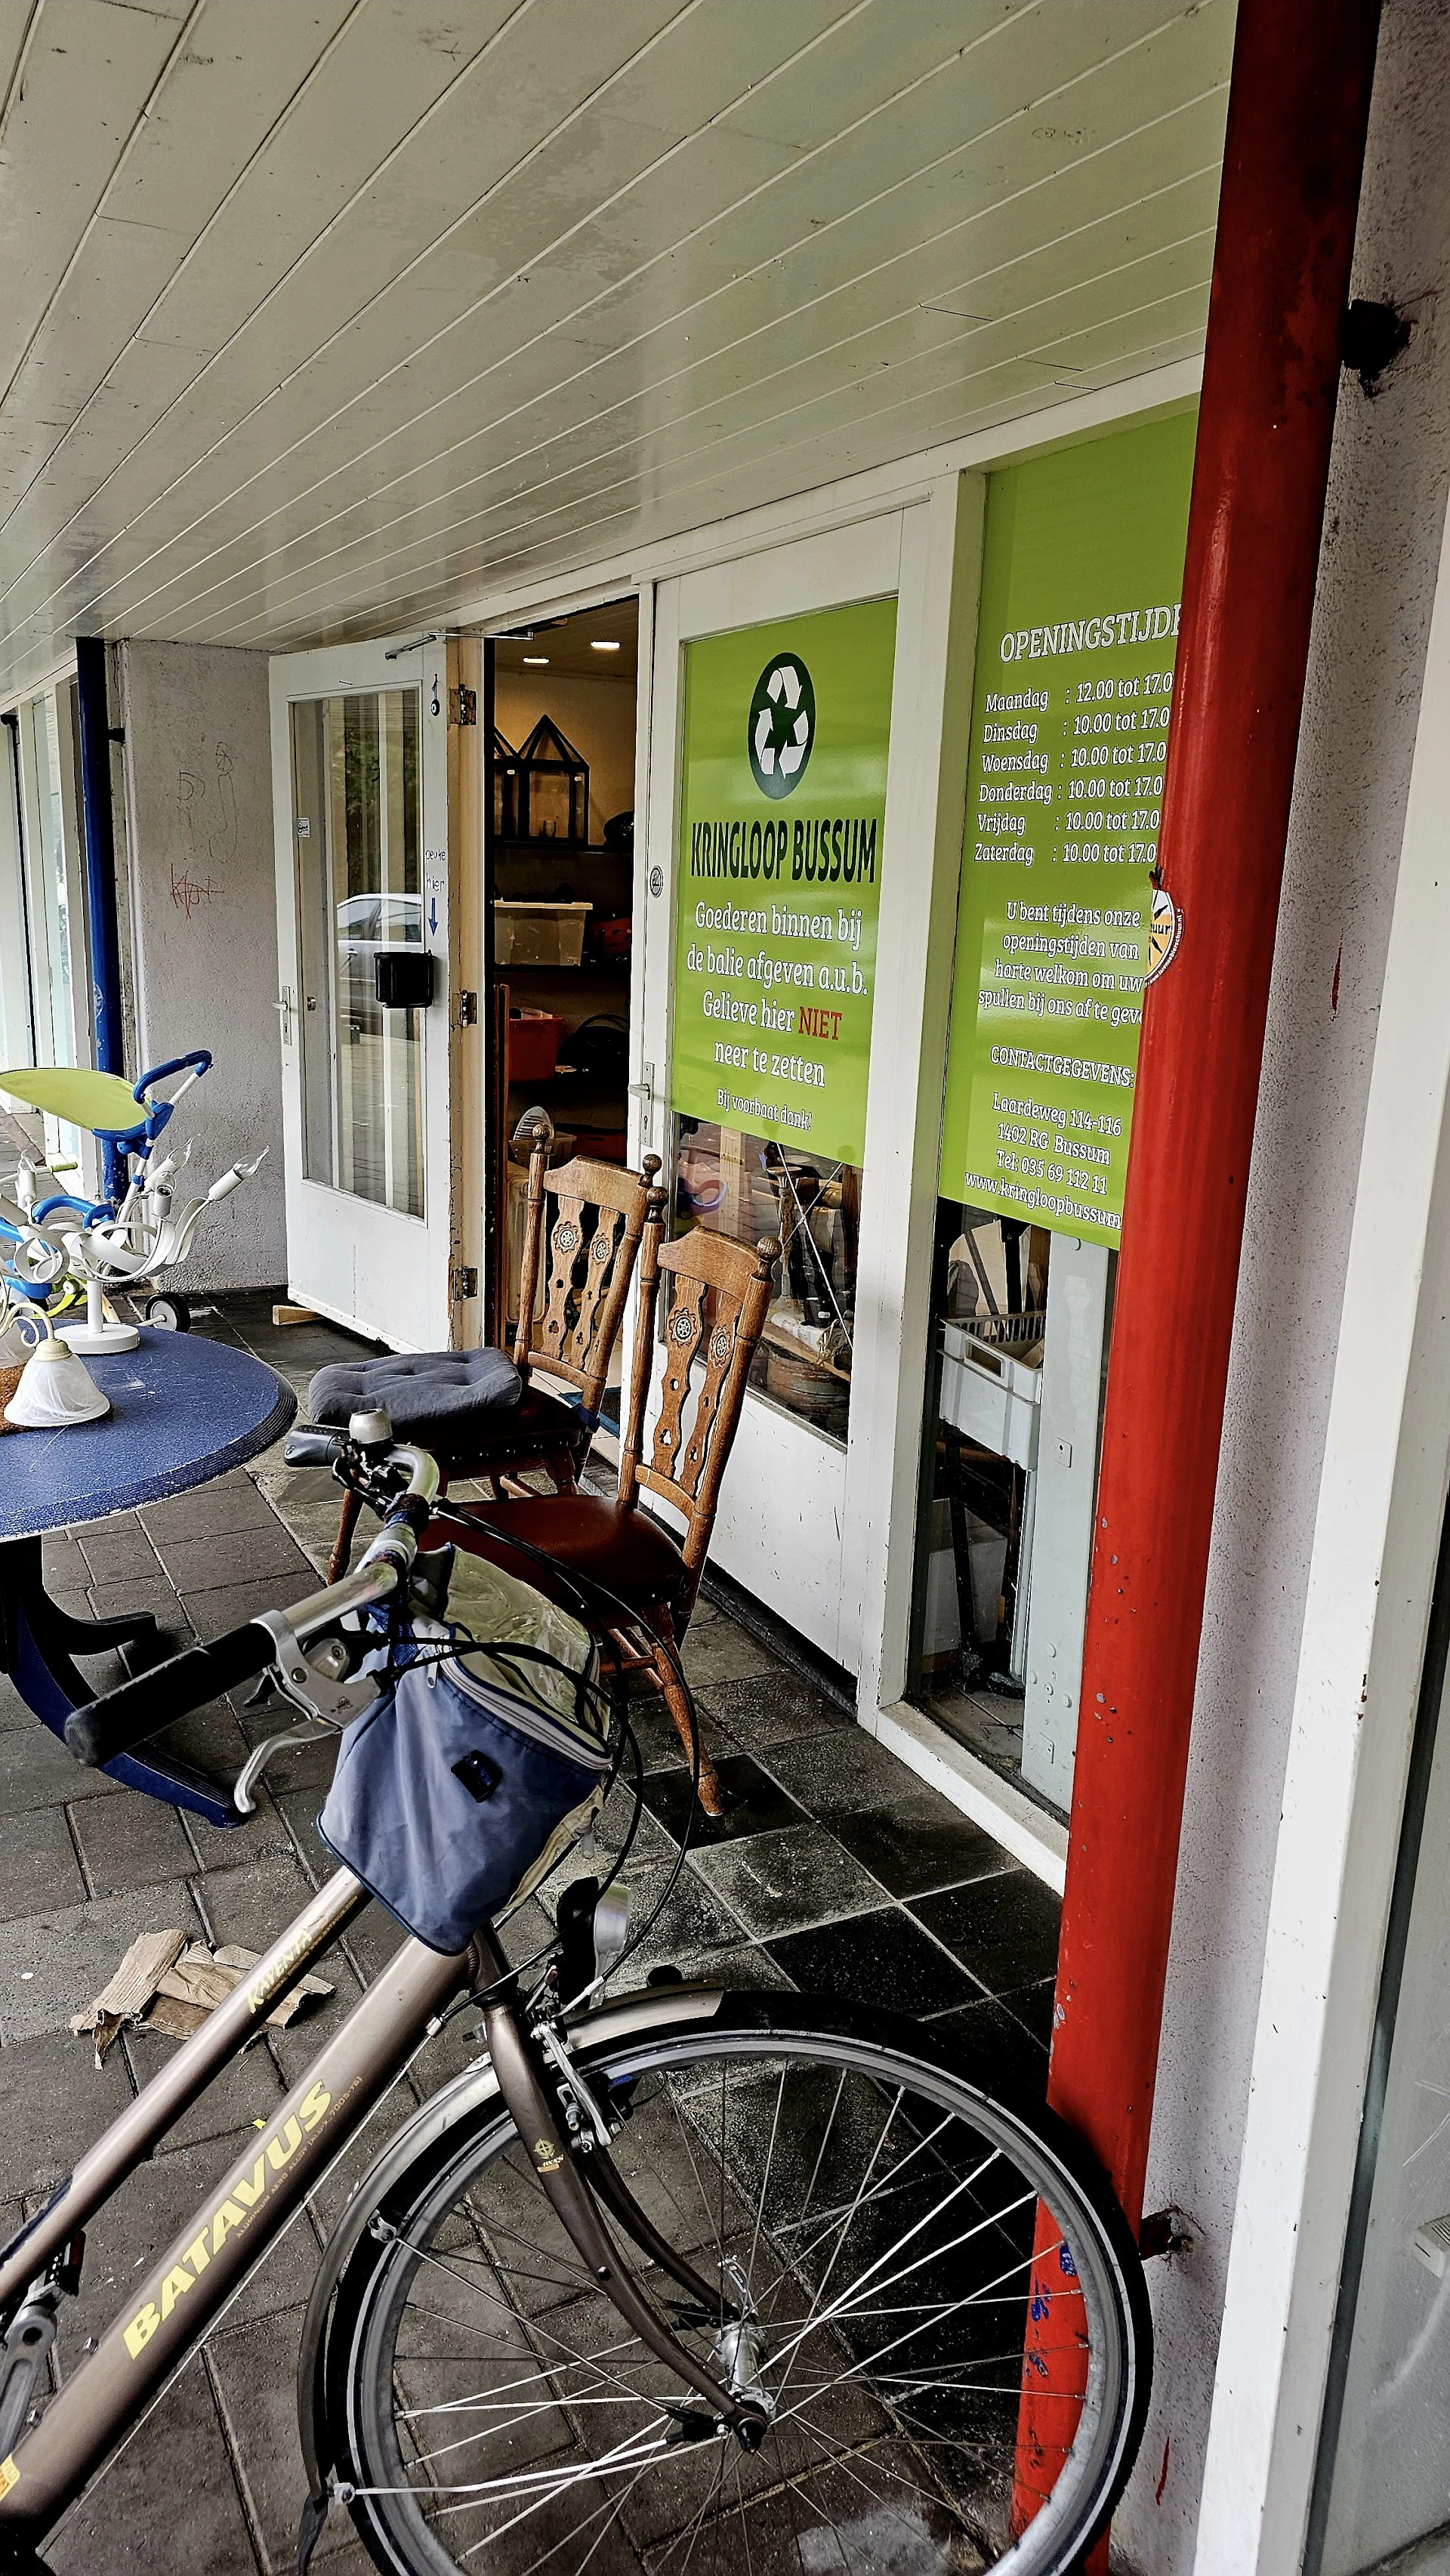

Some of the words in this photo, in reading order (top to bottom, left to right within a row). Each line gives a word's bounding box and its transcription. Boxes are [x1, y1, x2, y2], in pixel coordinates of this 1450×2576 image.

[999, 603, 1181, 663] OPENINGSTIJD
[985, 688, 1049, 712] Maandag
[1076, 679, 1115, 703] 12.00
[1118, 677, 1140, 697] tot
[1143, 671, 1173, 695] 17.0
[983, 720, 1038, 744] Dinsdag
[1073, 712, 1112, 735] 10.00
[1115, 711, 1137, 733] tot
[1140, 706, 1171, 730] 17.0
[981, 750, 1050, 774] Woensdag
[1070, 746, 1109, 768] 10.00
[1112, 744, 1134, 765] tot
[1137, 741, 1167, 764] 17.0
[979, 781, 1053, 806] Donderdag
[1067, 779, 1106, 801] 10.00
[1109, 777, 1131, 798] tot
[1134, 775, 1164, 797] 17.0
[977, 812, 1026, 837] Vrijdag
[1065, 811, 1103, 831] 10.00
[1106, 810, 1128, 830] tot
[1131, 809, 1160, 830] 17.0
[691, 820, 787, 879] KRINGLOOP
[792, 819, 877, 882] BUSSUM
[974, 842, 1034, 866] Zaterdag
[1062, 842, 1100, 863] 10.00
[1103, 843, 1125, 863] tot
[1128, 842, 1157, 863] 17.0
[426, 873, 445, 891] hier
[696, 901, 767, 934] Goederen
[772, 904, 832, 940] binnen
[838, 909, 862, 950] bij
[1007, 901, 1017, 920] U
[1020, 900, 1049, 922] bent
[1052, 902, 1101, 928] tijdens
[1103, 910, 1141, 928] onze
[1003, 931, 1106, 961] openingstijden
[1109, 942, 1140, 960] van
[687, 943, 703, 972] de
[707, 944, 743, 977] balie
[747, 950, 814, 989] afgeven
[819, 961, 868, 996] a.u.b.
[995, 958, 1031, 981] harte
[1034, 963, 1089, 987] welkom
[1092, 974, 1115, 990] om
[1118, 976, 1145, 993] uw
[702, 990, 757, 1025] Gelieve
[760, 999, 795, 1032] hier
[798, 1006, 842, 1041] NIET
[977, 987, 1026, 1012] spullen
[1027, 990, 1045, 1017] bij
[1047, 999, 1072, 1016] ons
[1075, 998, 1093, 1018] af
[1094, 1001, 1109, 1021] te
[1110, 1005, 1143, 1027] gev
[714, 1041, 748, 1069] neer
[752, 1047, 767, 1074] te
[771, 1052, 825, 1087] zetten
[990, 1045, 1135, 1089] CONTACTGEGEVENS:
[717, 1088, 730, 1113] Bij
[732, 1093, 779, 1123] voorbaat
[780, 1104, 812, 1132] dank!
[992, 1092, 1066, 1129] Laardeweg
[1069, 1108, 1121, 1138] 114-116
[998, 1123, 1027, 1144] 1402
[1029, 1129, 1049, 1151] RG
[1053, 1134, 1111, 1166] Bussum
[996, 1148, 1020, 1172] Tel:
[1021, 1157, 1045, 1178] 035
[1047, 1163, 1063, 1182] 69
[1066, 1167, 1089, 1191] 112
[1091, 1175, 1107, 1195] 11
[964, 1172, 1121, 1230] www.kringloopbussum
[247, 1926, 312, 2014] KAYENTA
[122, 2080, 332, 2361] BATAVUS
